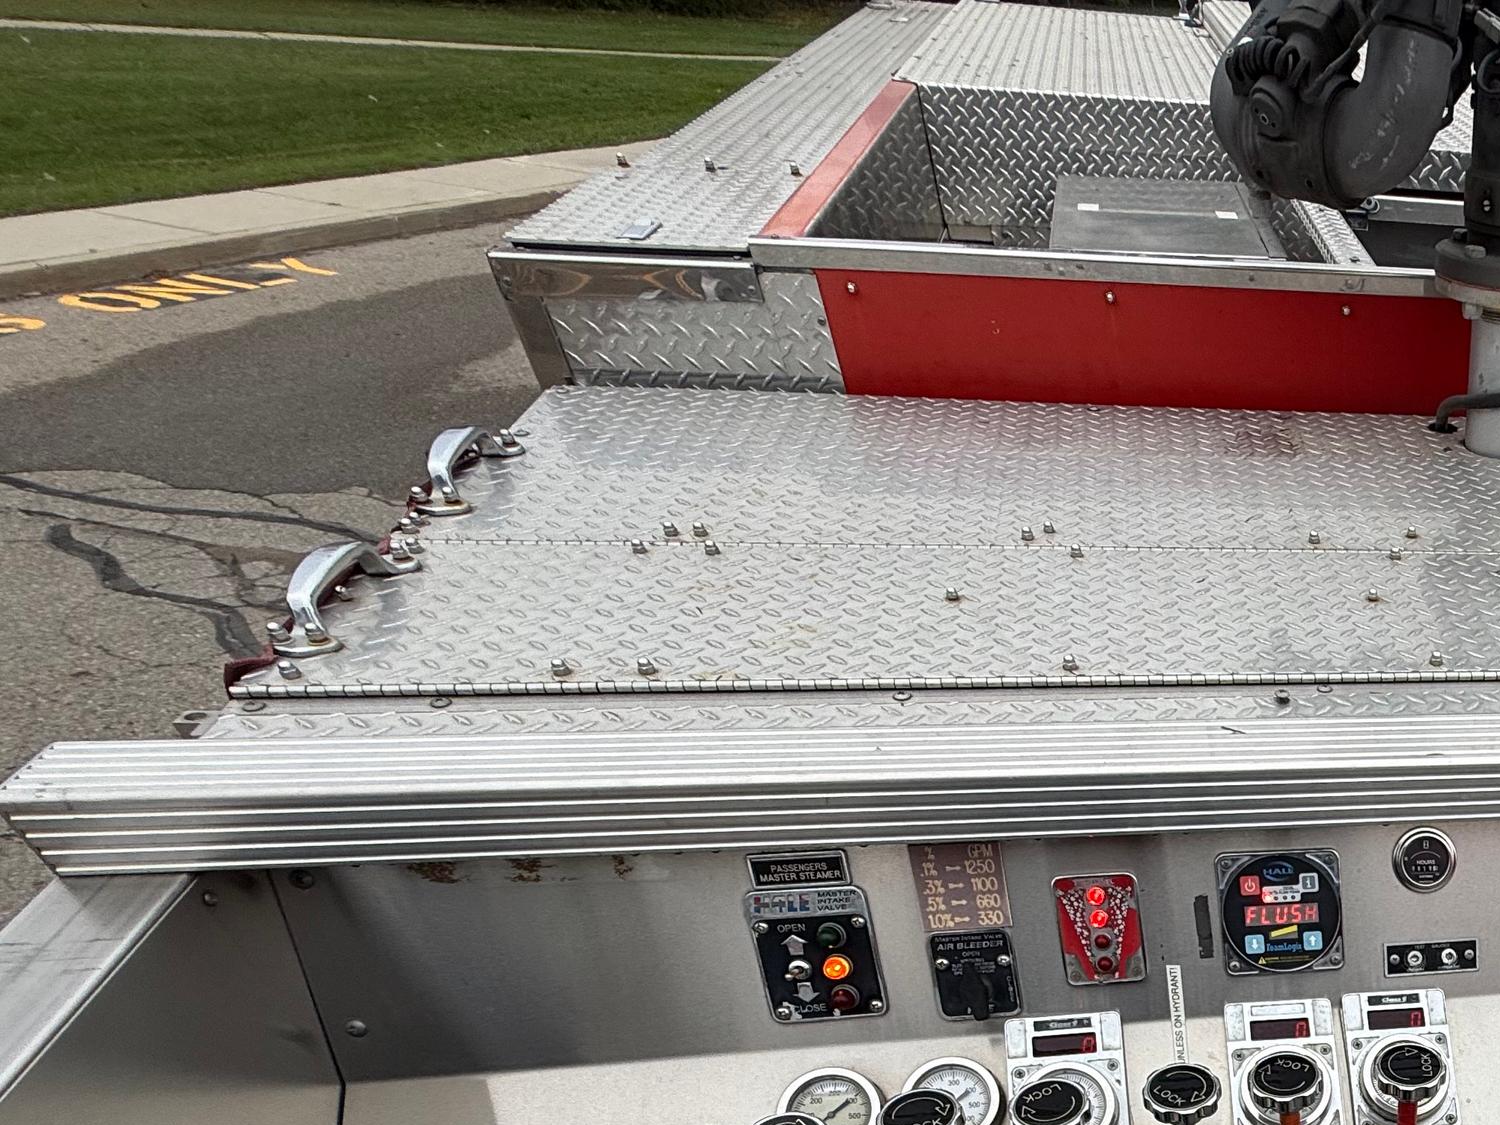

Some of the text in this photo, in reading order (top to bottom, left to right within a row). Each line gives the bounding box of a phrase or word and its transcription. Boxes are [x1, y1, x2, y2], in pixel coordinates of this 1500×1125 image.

[58, 257, 338, 313] ONLY
[968, 844, 994, 858] GPM
[770, 862, 828, 874] PASSENGERS
[964, 859, 996, 874] 1250
[1263, 867, 1294, 875] HALE
[760, 870, 842, 882] MASTER STEAMER
[923, 876, 998, 895] .3% 1100
[817, 890, 857, 898] MASTER
[754, 893, 810, 914] HALE
[818, 904, 848, 912] VALVE
[926, 893, 1001, 912] .5% 660
[978, 911, 1004, 926] 330
[1247, 904, 1316, 924] FLUSH
[777, 923, 806, 934] OPEN
[937, 940, 1004, 952] AIR BLEEDER
[1170, 967, 1183, 1029] ON HYDRANT!
[794, 1003, 828, 1012] CLOSE
[1274, 1056, 1310, 1072] LOCK
[1420, 1052, 1432, 1078] LOCK
[1022, 1083, 1062, 1104] LOCK
[1153, 1085, 1186, 1105] LOCK
[848, 1112, 862, 1120] 500
